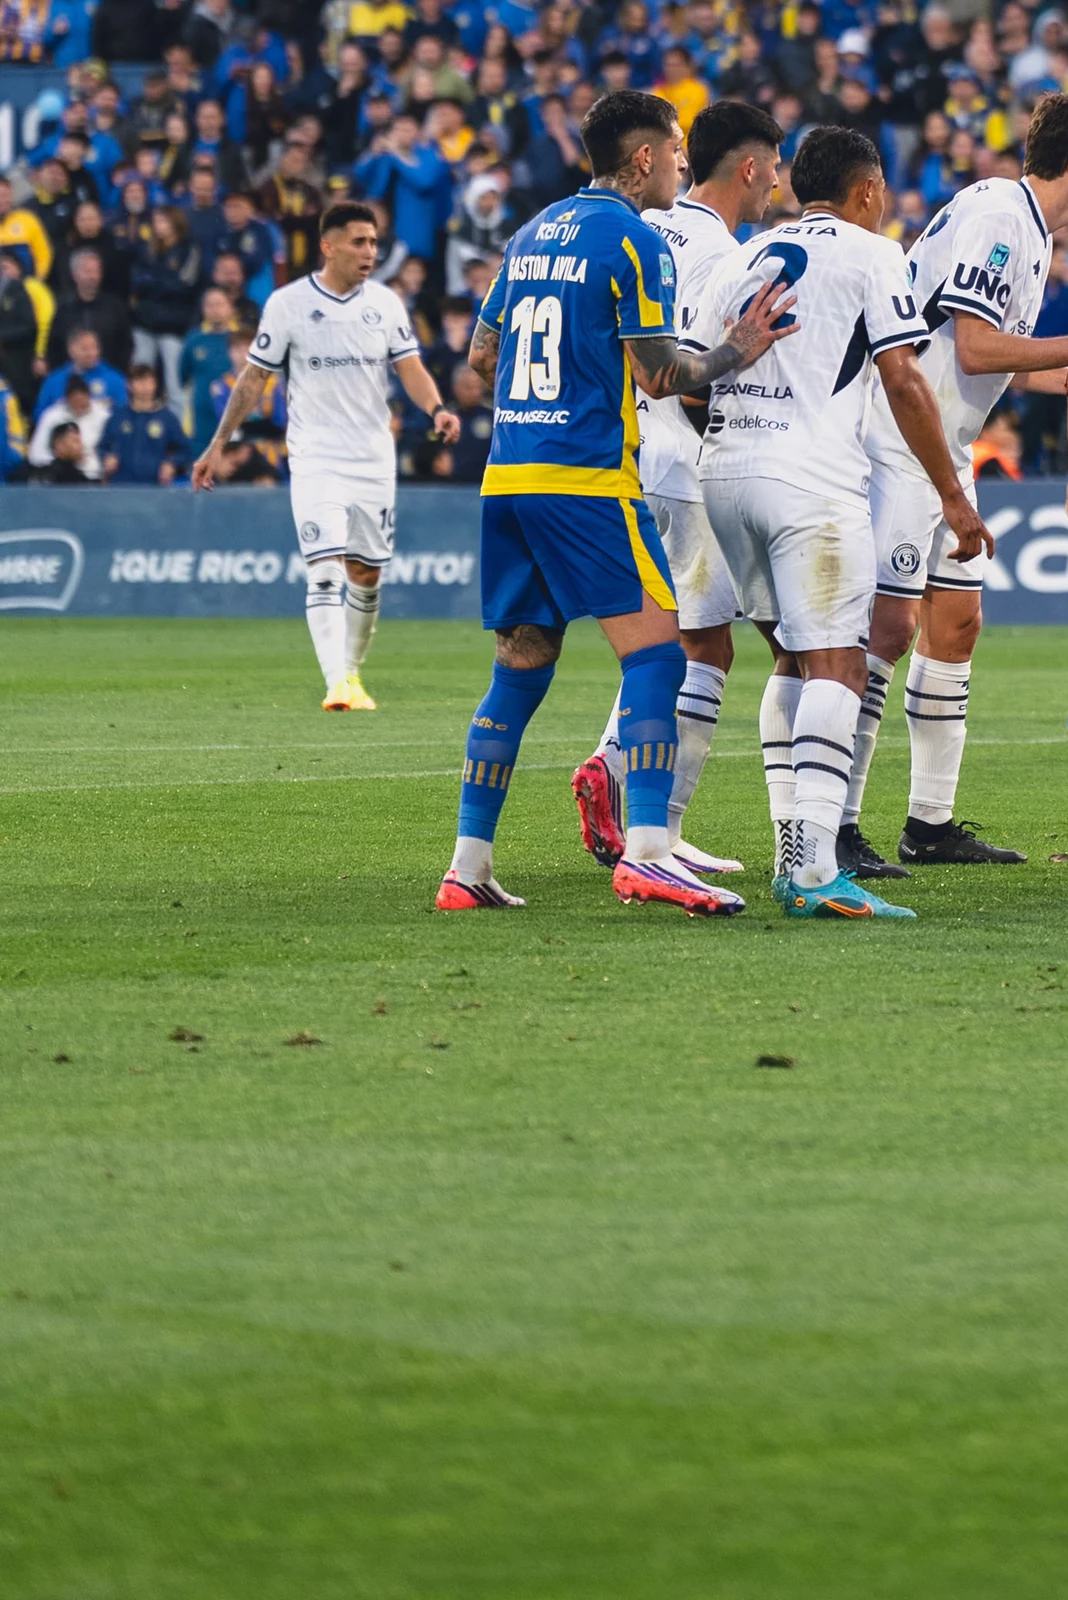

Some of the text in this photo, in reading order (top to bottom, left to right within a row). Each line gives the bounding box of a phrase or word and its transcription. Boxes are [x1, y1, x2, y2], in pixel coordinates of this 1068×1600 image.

[535, 222, 581, 246] kanji
[507, 255, 588, 283] GASTON AVILA
[739, 242, 808, 331] 2
[509, 296, 562, 401] 13
[714, 383, 793, 399] ZANELLA
[499, 410, 570, 424] TRANSELEC
[729, 415, 789, 431] edelcos
[198, 551, 283, 584] RICO
